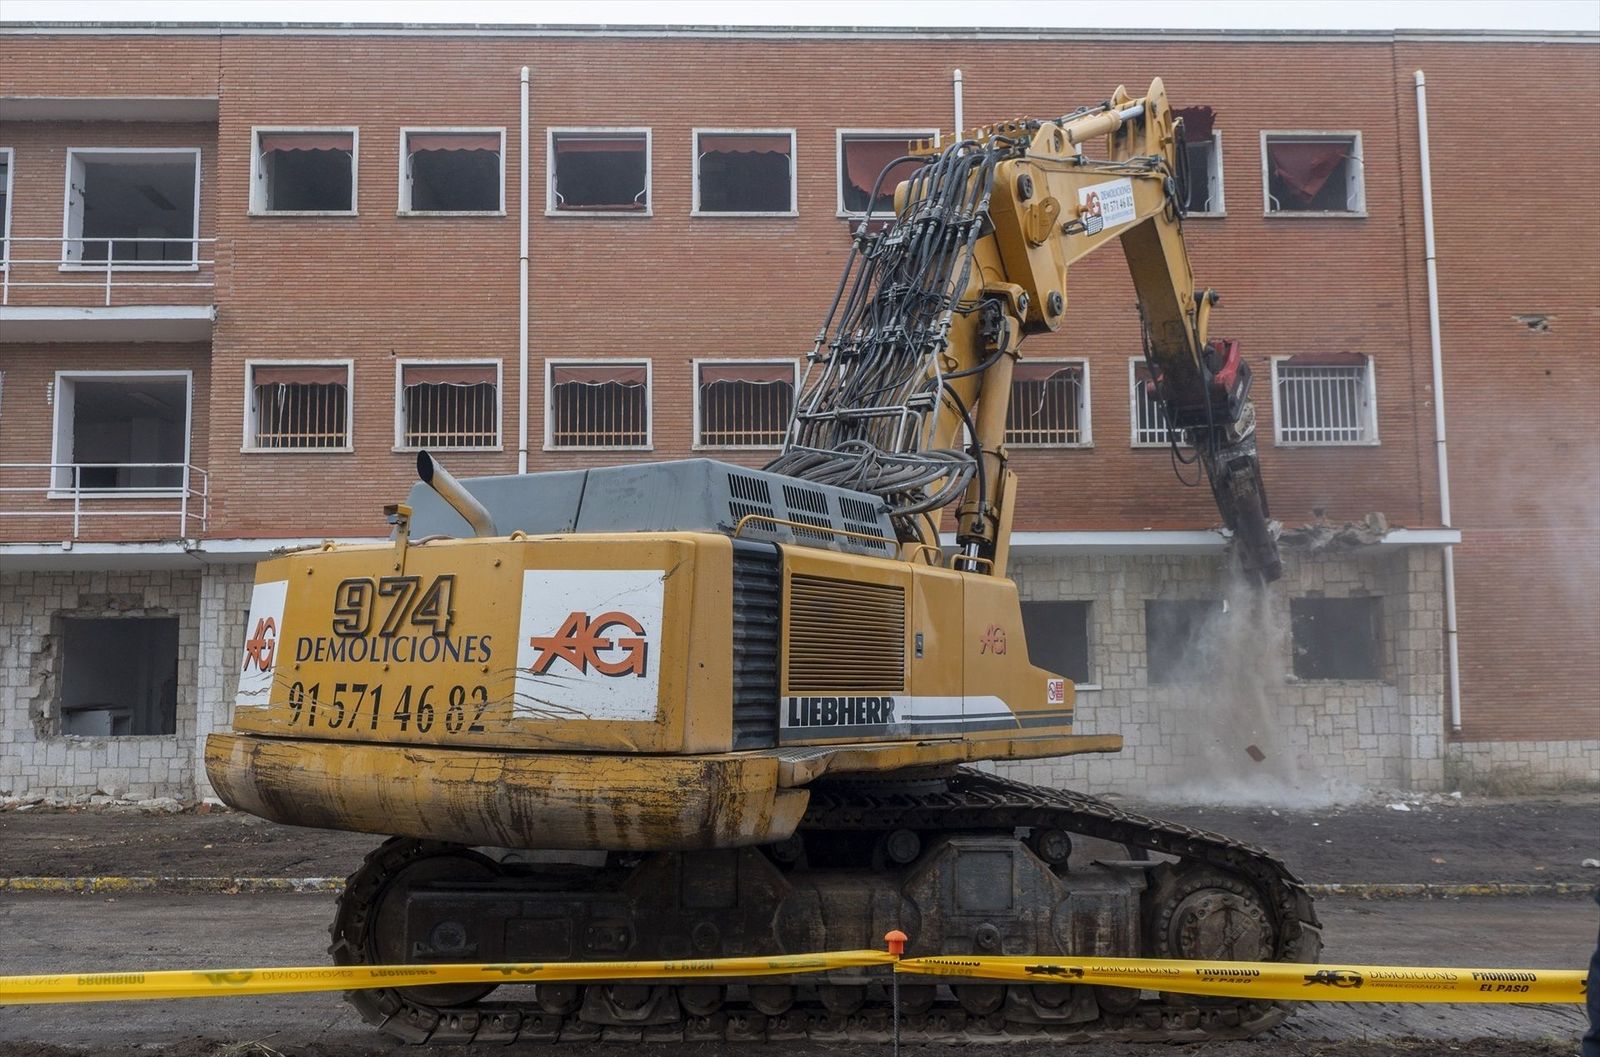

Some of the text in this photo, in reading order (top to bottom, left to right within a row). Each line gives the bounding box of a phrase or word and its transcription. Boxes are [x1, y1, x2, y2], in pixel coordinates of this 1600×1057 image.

[333, 573, 457, 637] 974
[243, 616, 276, 673] AG
[295, 634, 492, 664] DEMOLICIONES
[530, 611, 647, 678] AG
[288, 681, 488, 735] 91 571 46 82
[788, 696, 896, 728] LIEBHERR
[1369, 971, 1458, 981] DEMOLICIONES
[1472, 971, 1537, 982] PROHIBIDO
[1480, 984, 1530, 993] EL PASO
